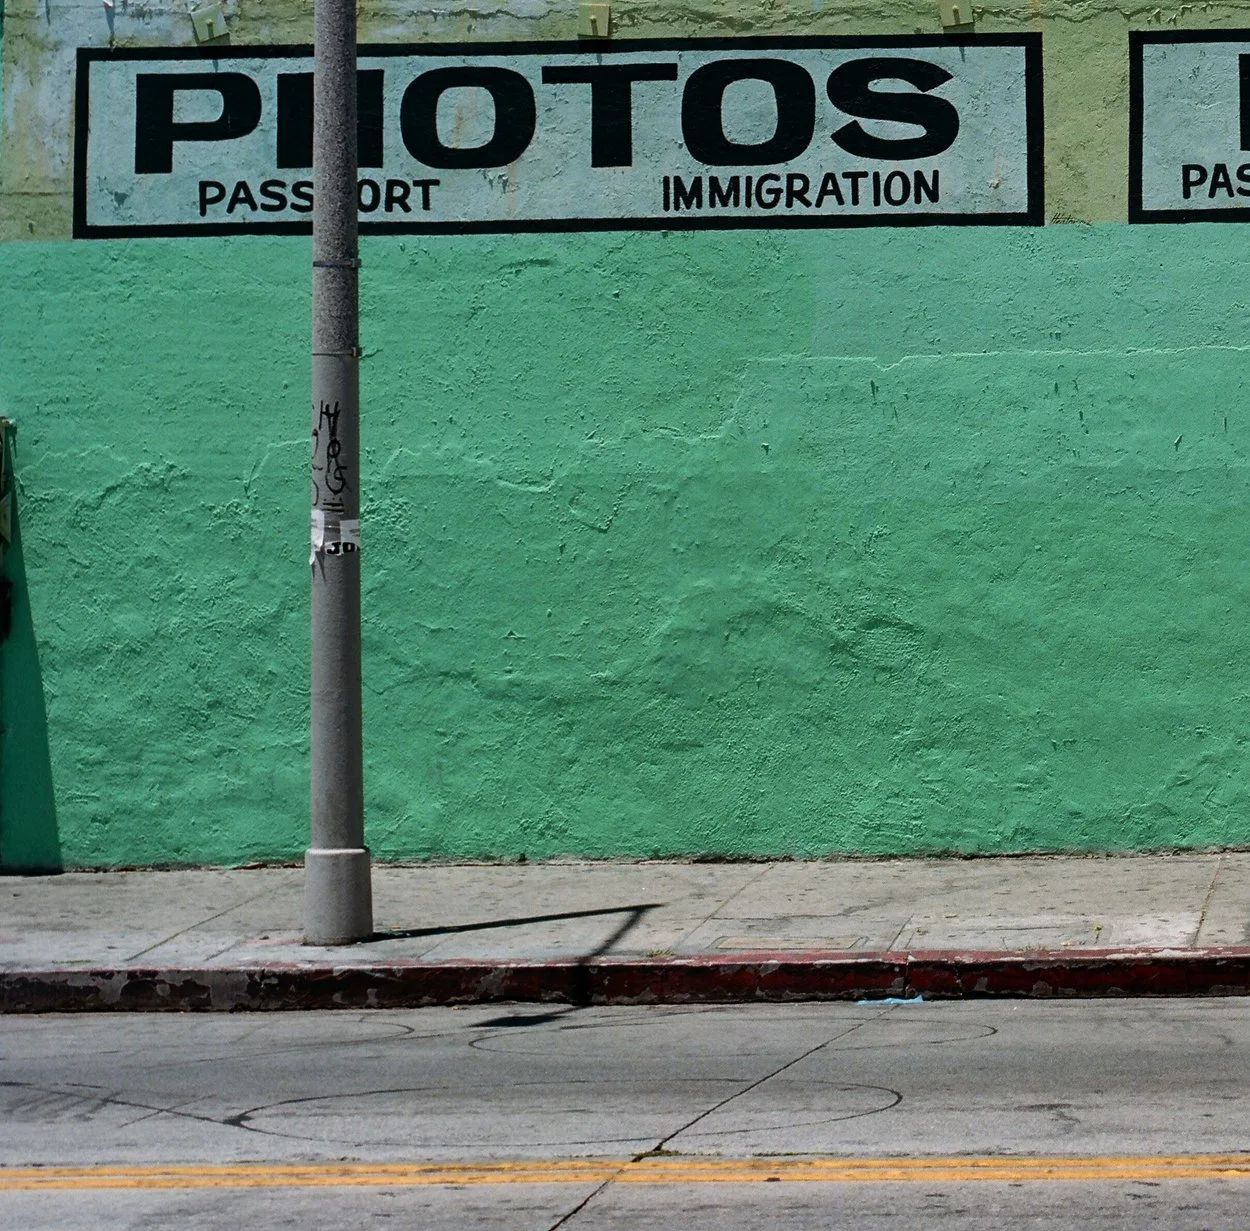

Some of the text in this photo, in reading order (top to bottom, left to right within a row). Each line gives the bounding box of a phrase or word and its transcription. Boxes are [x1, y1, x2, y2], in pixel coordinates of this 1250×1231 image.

[135, 57, 960, 174] PHOTOS
[198, 169, 940, 217] PASSORT IMMIGRATION
